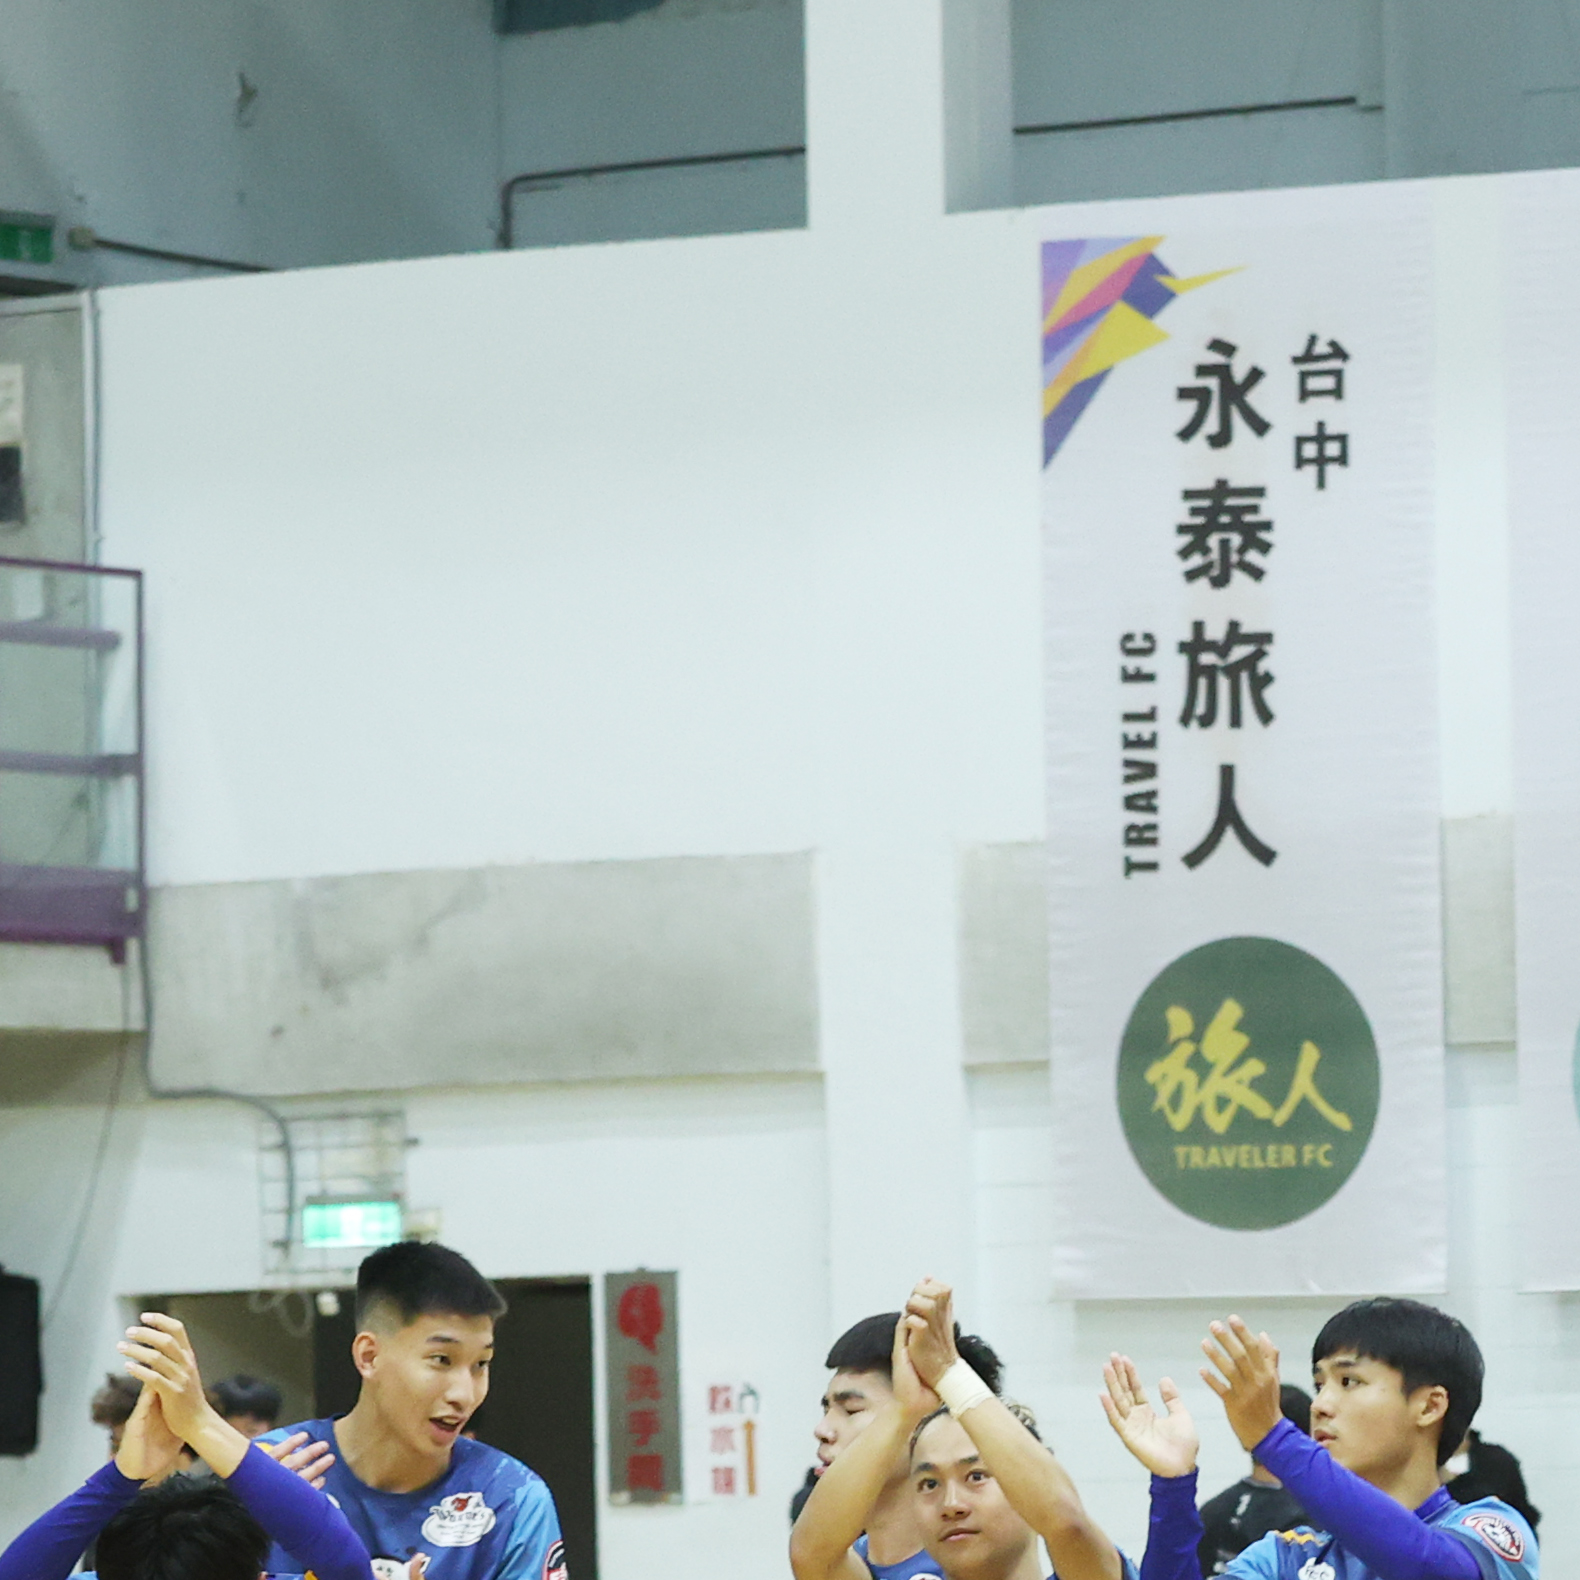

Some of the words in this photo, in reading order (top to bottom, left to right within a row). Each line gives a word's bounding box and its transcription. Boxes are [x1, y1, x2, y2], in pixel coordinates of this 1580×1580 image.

[1290, 333, 1350, 490] 台中
[1120, 631, 1158, 684] FC
[1174, 338, 1278, 870] 永泰旅人
[1122, 706, 1160, 879] TRAVEL
[1144, 997, 1353, 1134] 旅人
[1173, 1145, 1296, 1170] TRAVELER
[1302, 1143, 1334, 1167] FC
